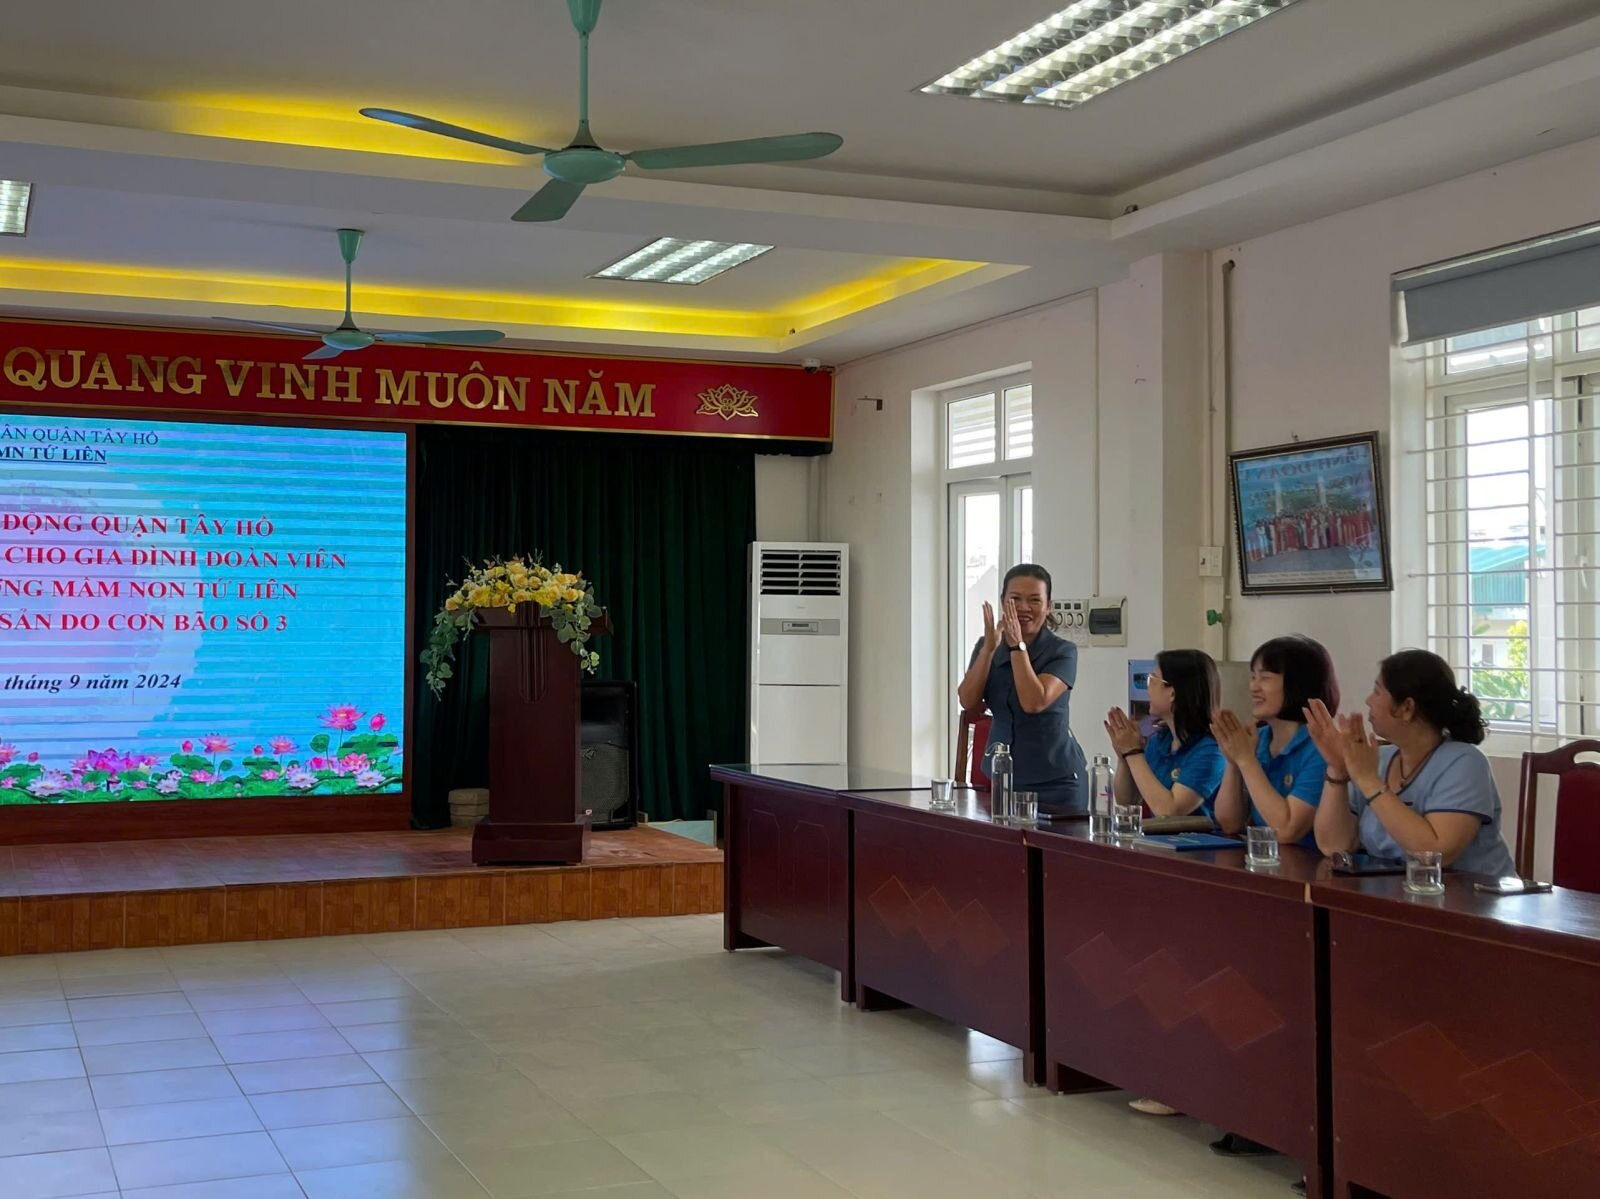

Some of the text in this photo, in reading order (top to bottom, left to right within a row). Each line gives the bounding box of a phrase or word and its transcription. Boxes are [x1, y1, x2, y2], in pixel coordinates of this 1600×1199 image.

[3, 346, 657, 417] QUANG VINH MUÔN NĂM
[32, 426, 86, 445] QUẬN
[90, 428, 128, 445] TÂY
[29, 444, 59, 460] TỨ
[62, 446, 107, 462] LIÊN
[2, 512, 83, 535] ĐỘNG
[91, 514, 168, 538] QUẬN
[175, 513, 228, 536] TÂY
[4, 544, 347, 569] CHO GIA ĐÌNH ĐOÀN VIÊN
[0, 578, 43, 597] NG
[129, 581, 186, 599] NON
[193, 577, 232, 600] TỨ
[237, 578, 299, 600] LIÊN
[0, 608, 288, 632] SẢN DO CƠN BÃO SỐ 3
[4, 673, 182, 694] tháng 9 năm 2024
